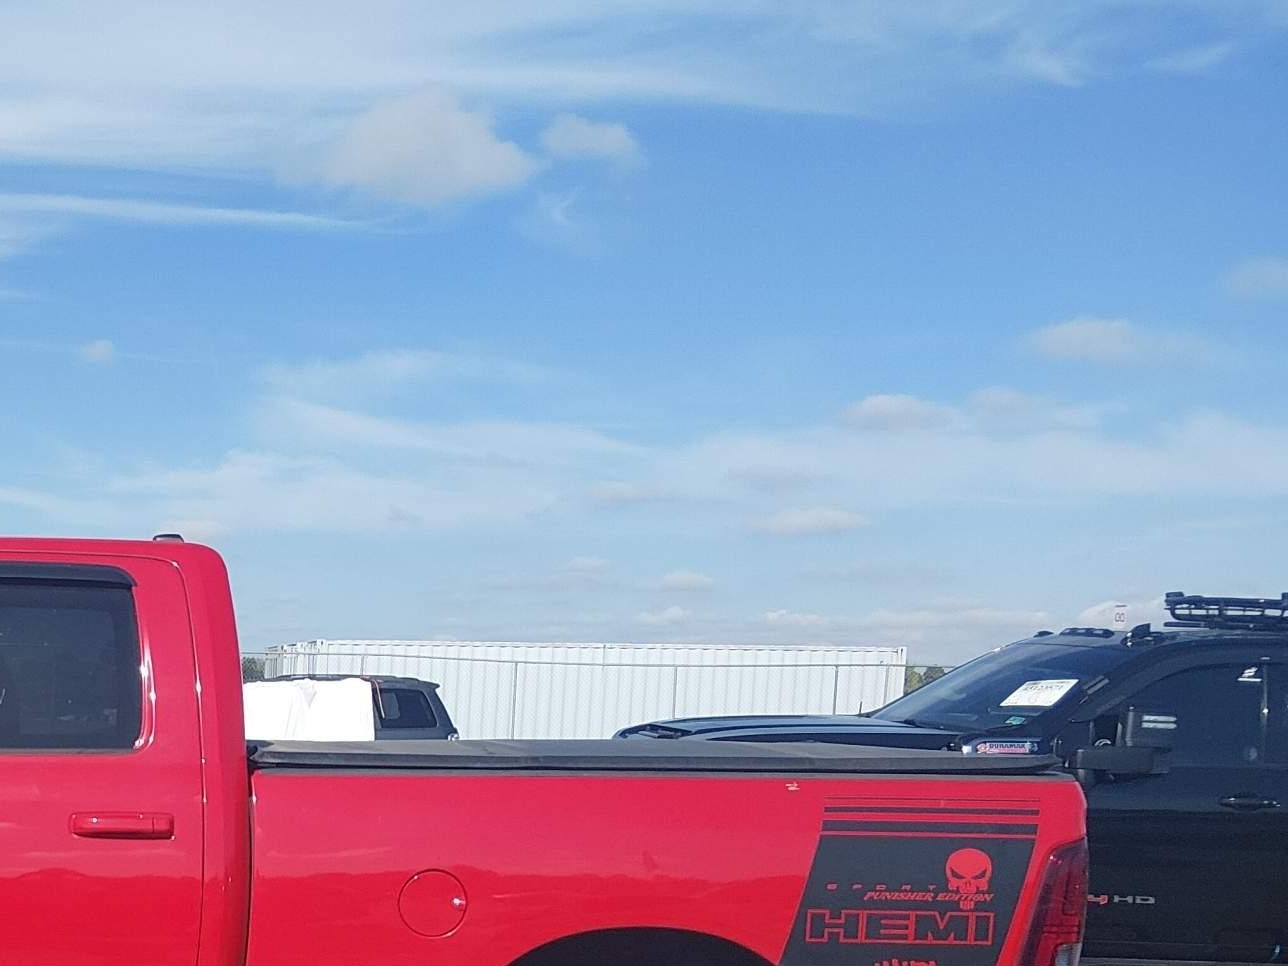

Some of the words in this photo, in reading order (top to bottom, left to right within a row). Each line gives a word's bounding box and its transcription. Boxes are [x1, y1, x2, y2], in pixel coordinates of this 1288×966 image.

[863, 891, 934, 901] PUNISHER
[935, 892, 995, 902] EDITION
[1113, 895, 1156, 904] HD
[805, 908, 995, 945] HEMI
